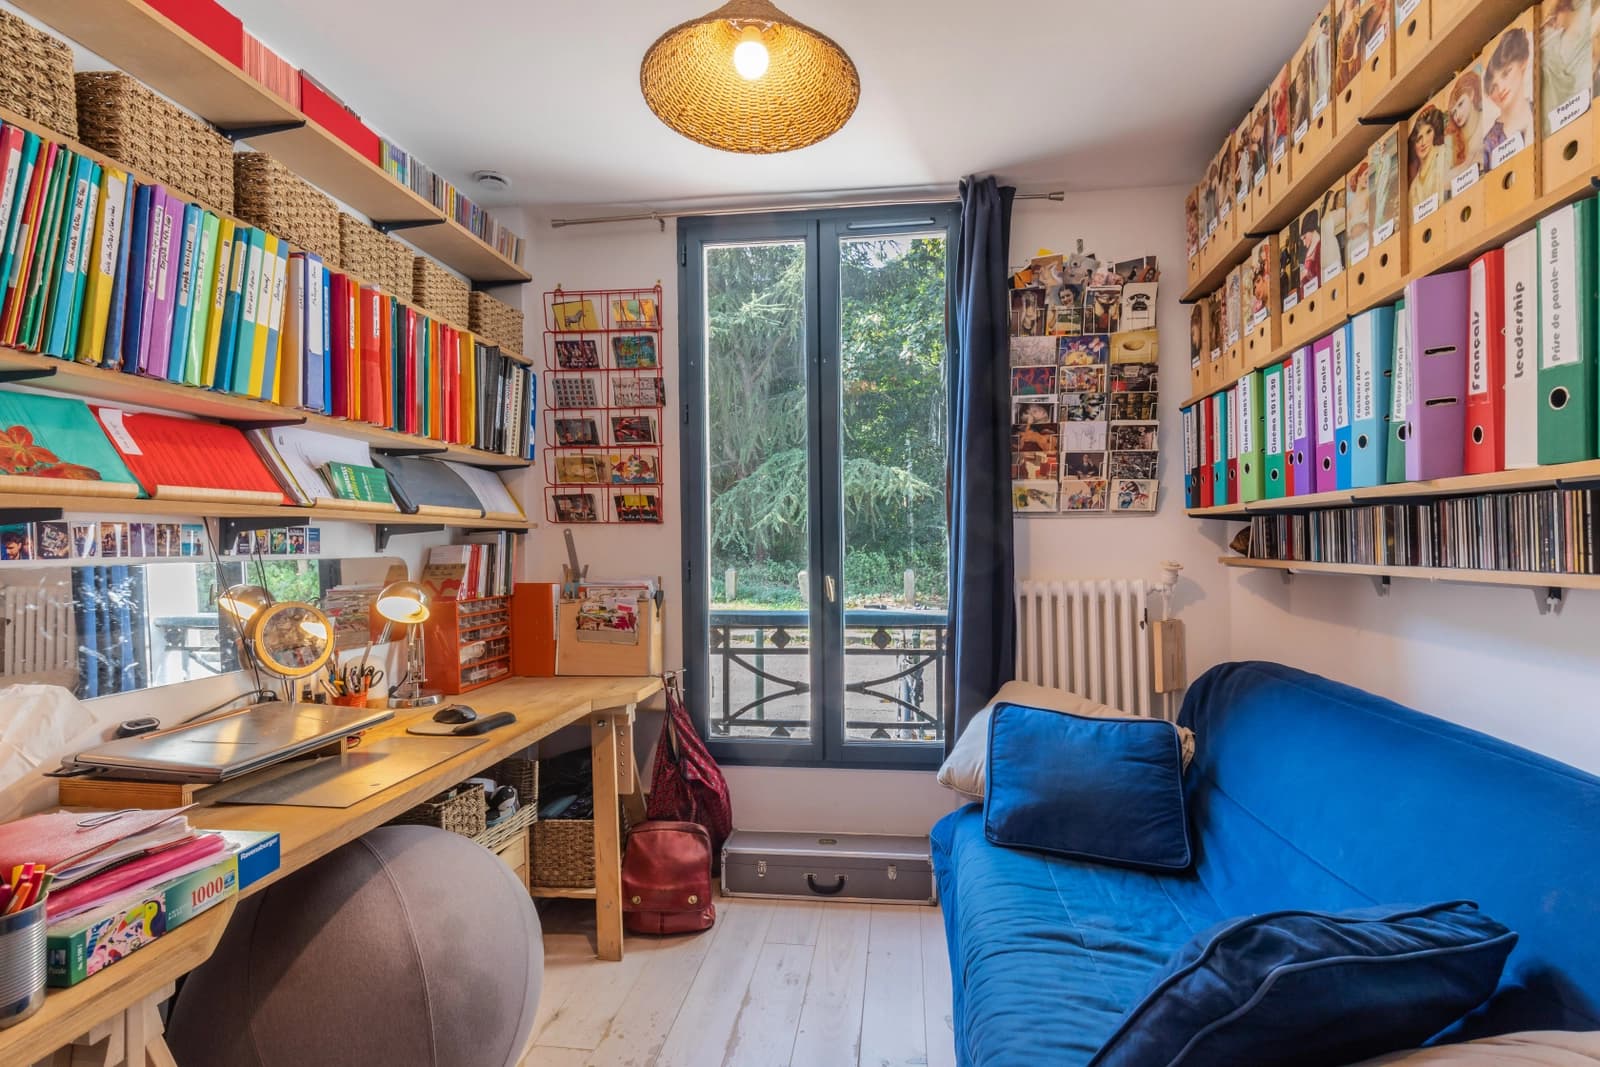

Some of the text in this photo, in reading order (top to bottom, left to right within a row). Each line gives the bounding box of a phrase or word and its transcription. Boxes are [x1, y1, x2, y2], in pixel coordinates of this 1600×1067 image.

[1550, 314, 1560, 330] de
[1472, 310, 1480, 390] Français
[1550, 332, 1561, 361] Prise
[240, 836, 278, 861] Ravensburger
[192, 876, 224, 906] 1000
